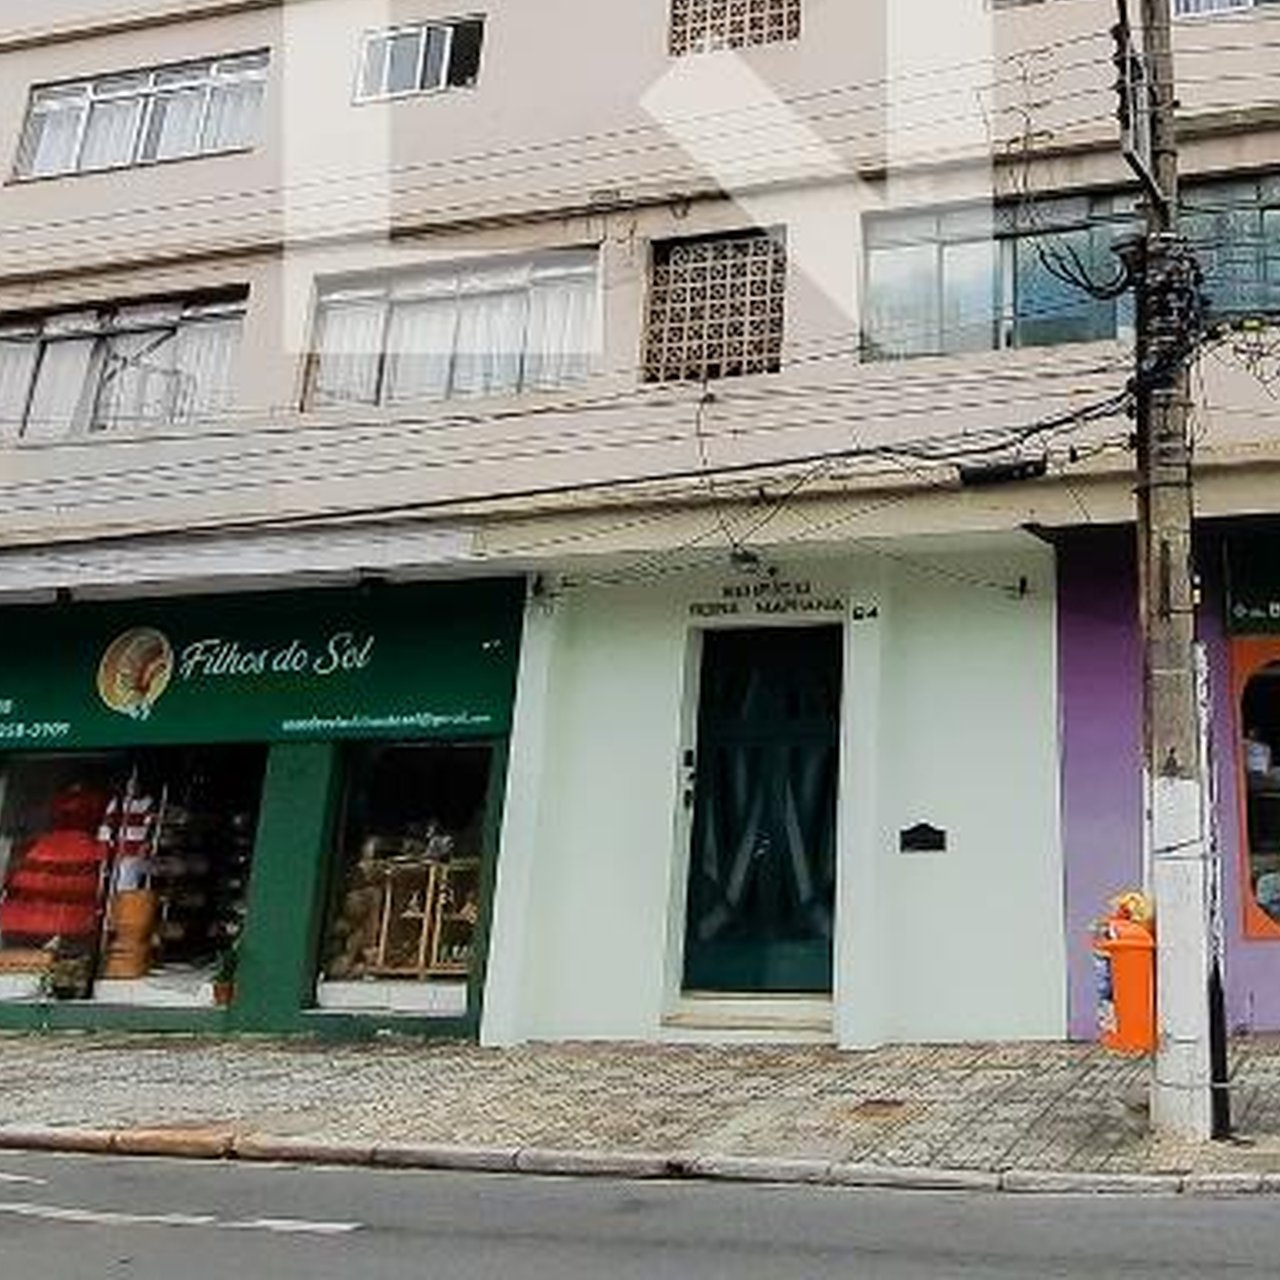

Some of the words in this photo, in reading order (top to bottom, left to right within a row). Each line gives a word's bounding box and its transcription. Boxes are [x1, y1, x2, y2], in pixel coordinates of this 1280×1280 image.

[179, 638, 270, 681] Filhos
[271, 639, 309, 672] do
[313, 631, 375, 675] Sol
